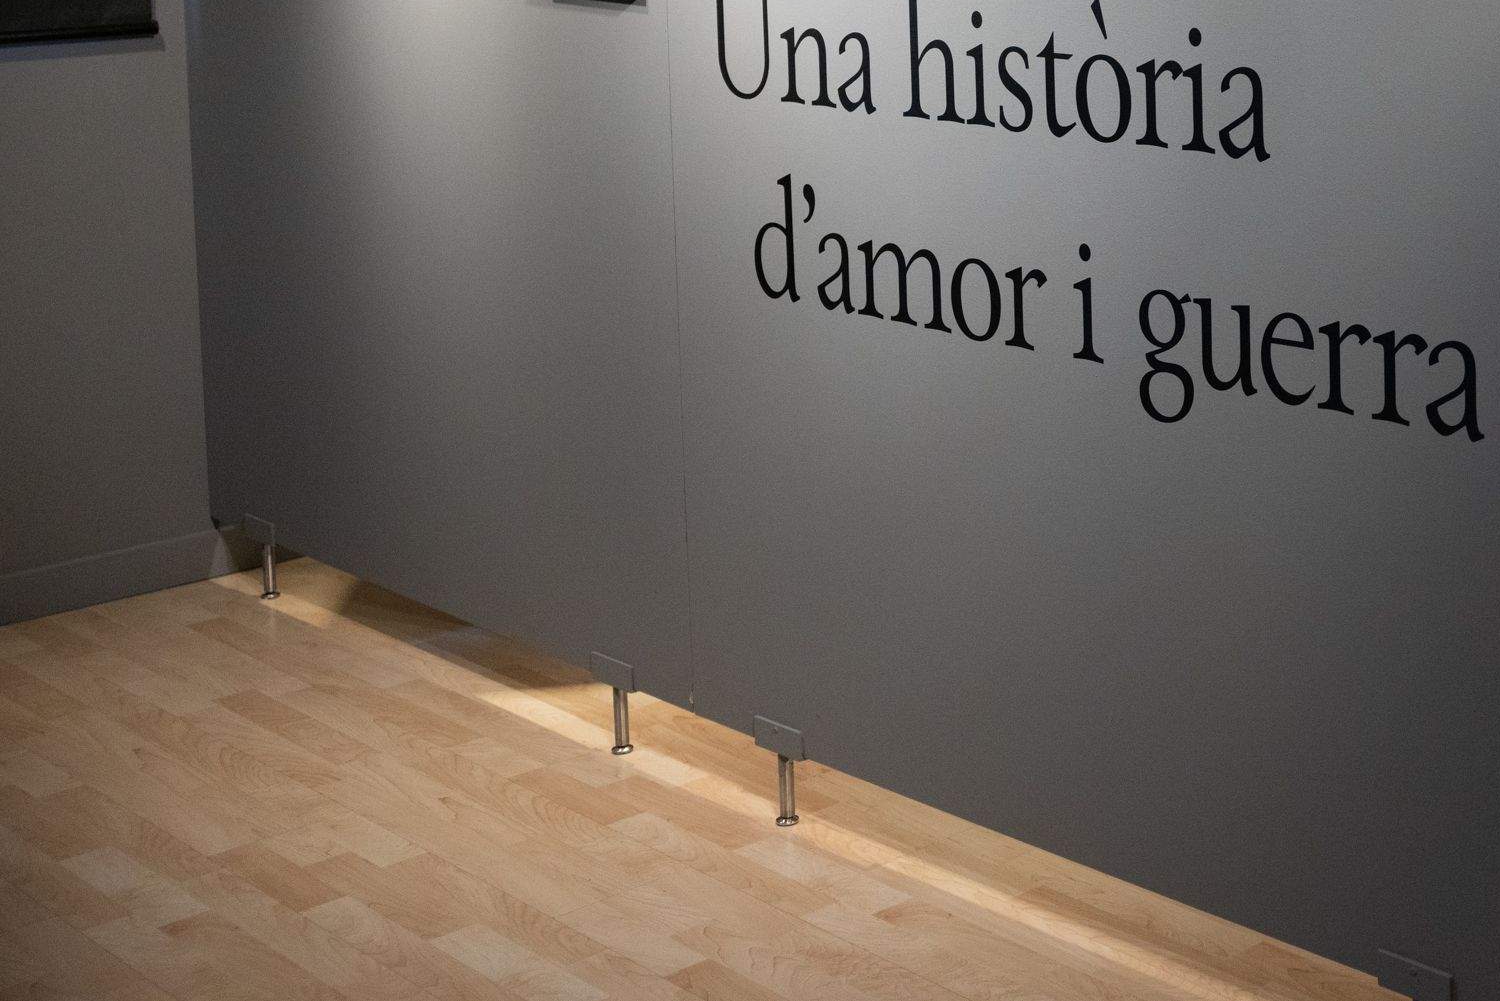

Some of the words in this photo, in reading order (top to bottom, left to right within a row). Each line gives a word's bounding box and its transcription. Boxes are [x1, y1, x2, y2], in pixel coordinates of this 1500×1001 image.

[753, 173, 1047, 351] d’amor
[1073, 243, 1104, 364] i
[1138, 289, 1485, 442] guerra
